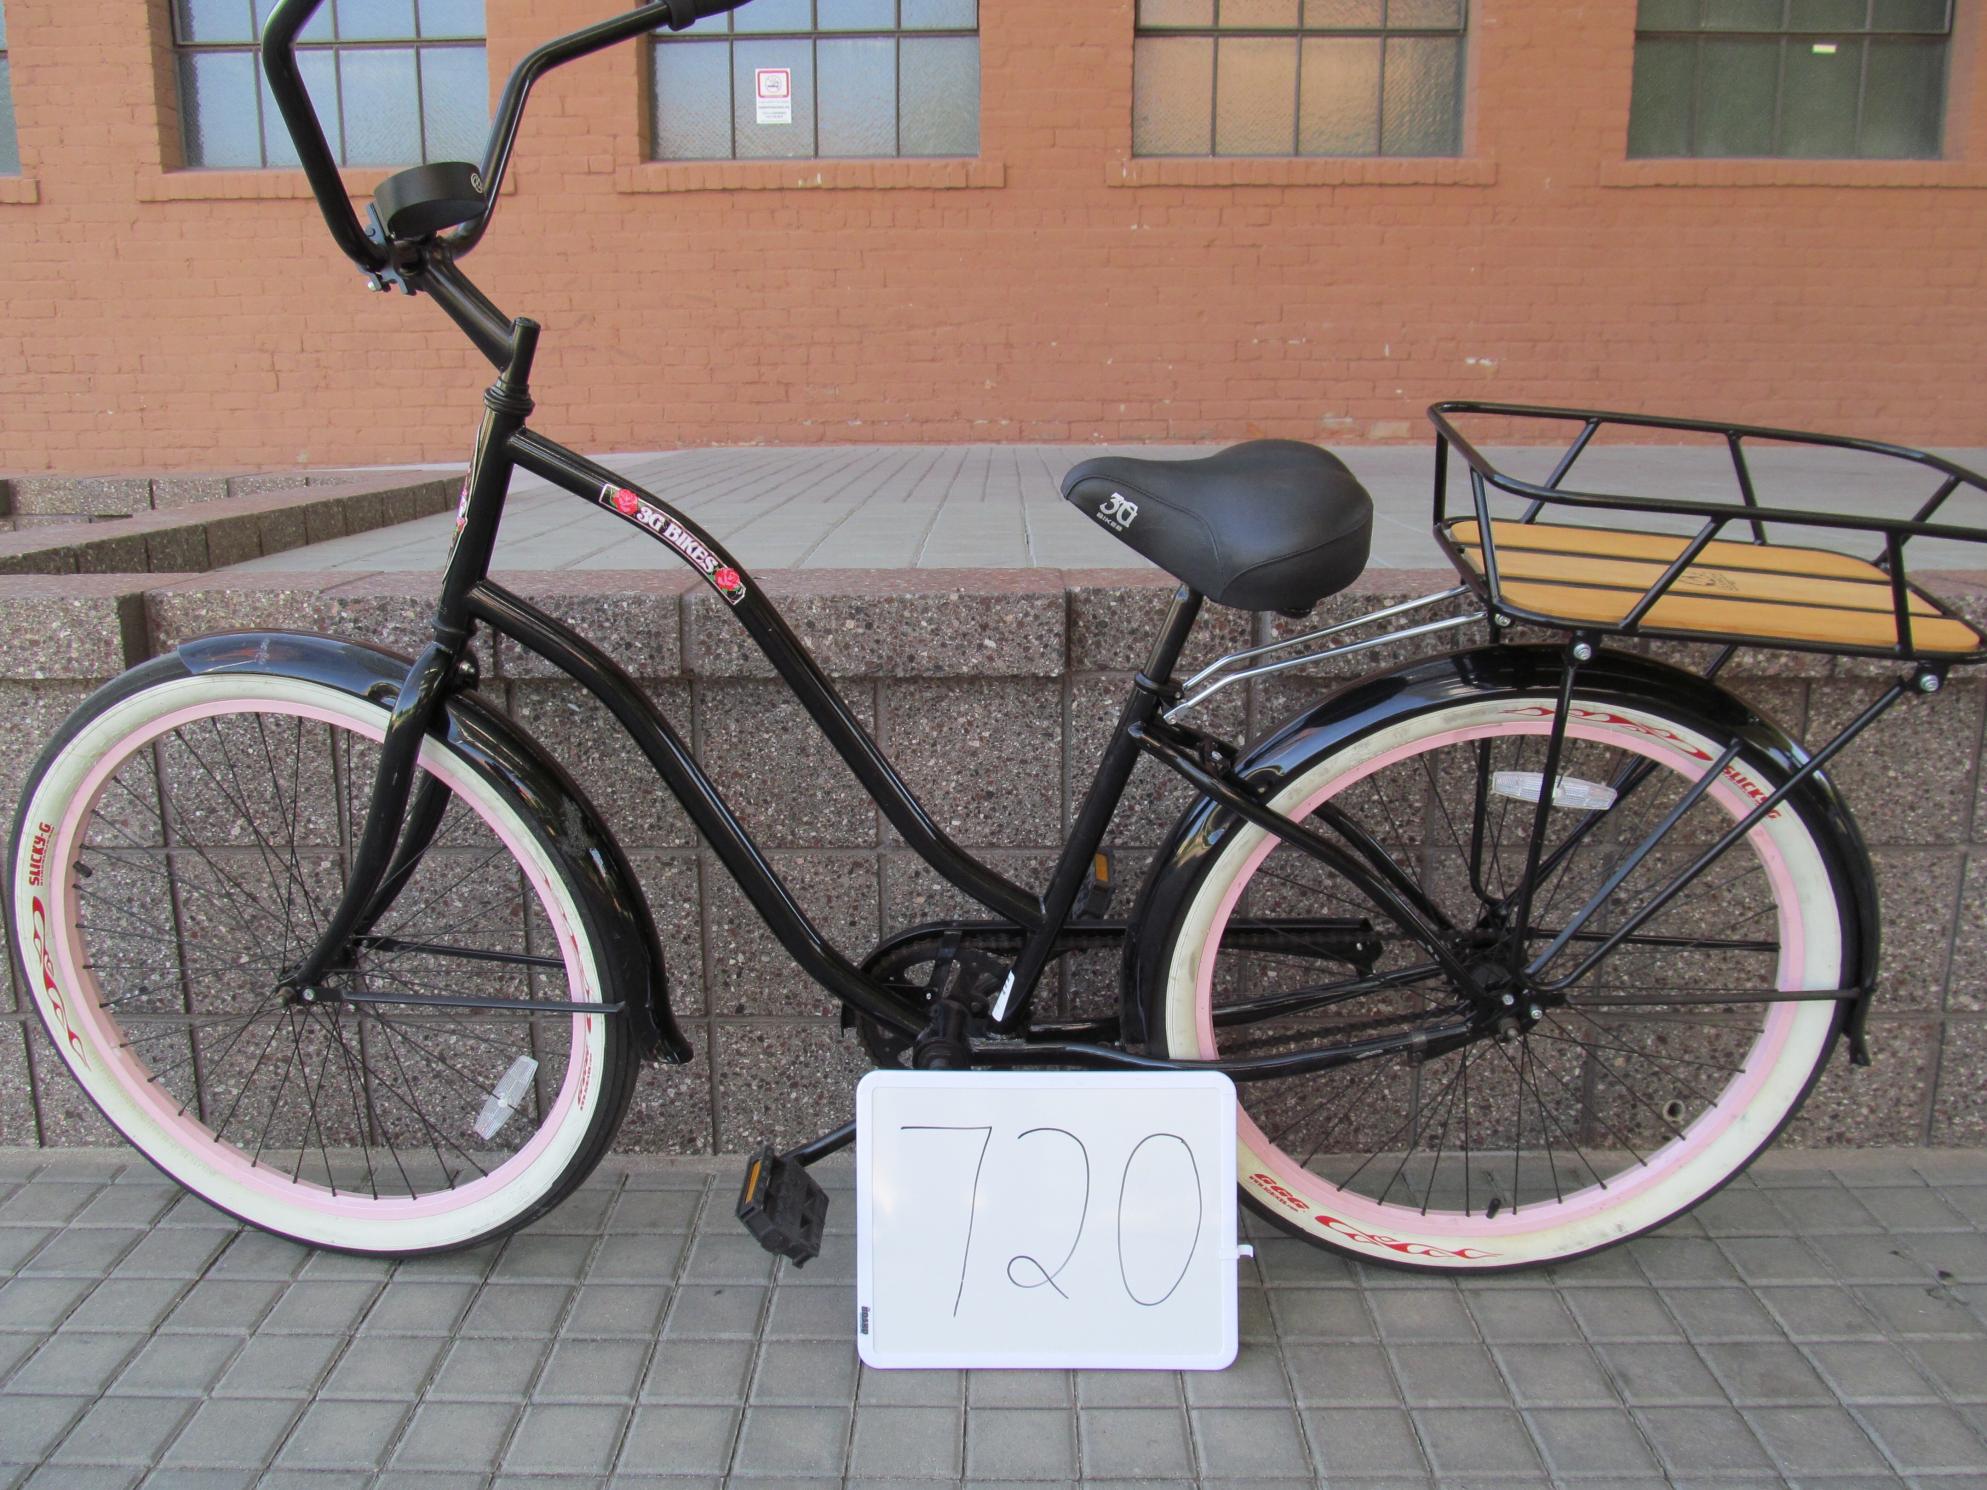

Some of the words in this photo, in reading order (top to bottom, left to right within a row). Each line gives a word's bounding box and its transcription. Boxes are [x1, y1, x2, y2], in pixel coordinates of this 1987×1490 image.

[636, 506, 666, 532] 3G
[662, 521, 719, 573] BIKES
[29, 822, 52, 886] SLICKY-G
[900, 1126, 1202, 1317] 720
